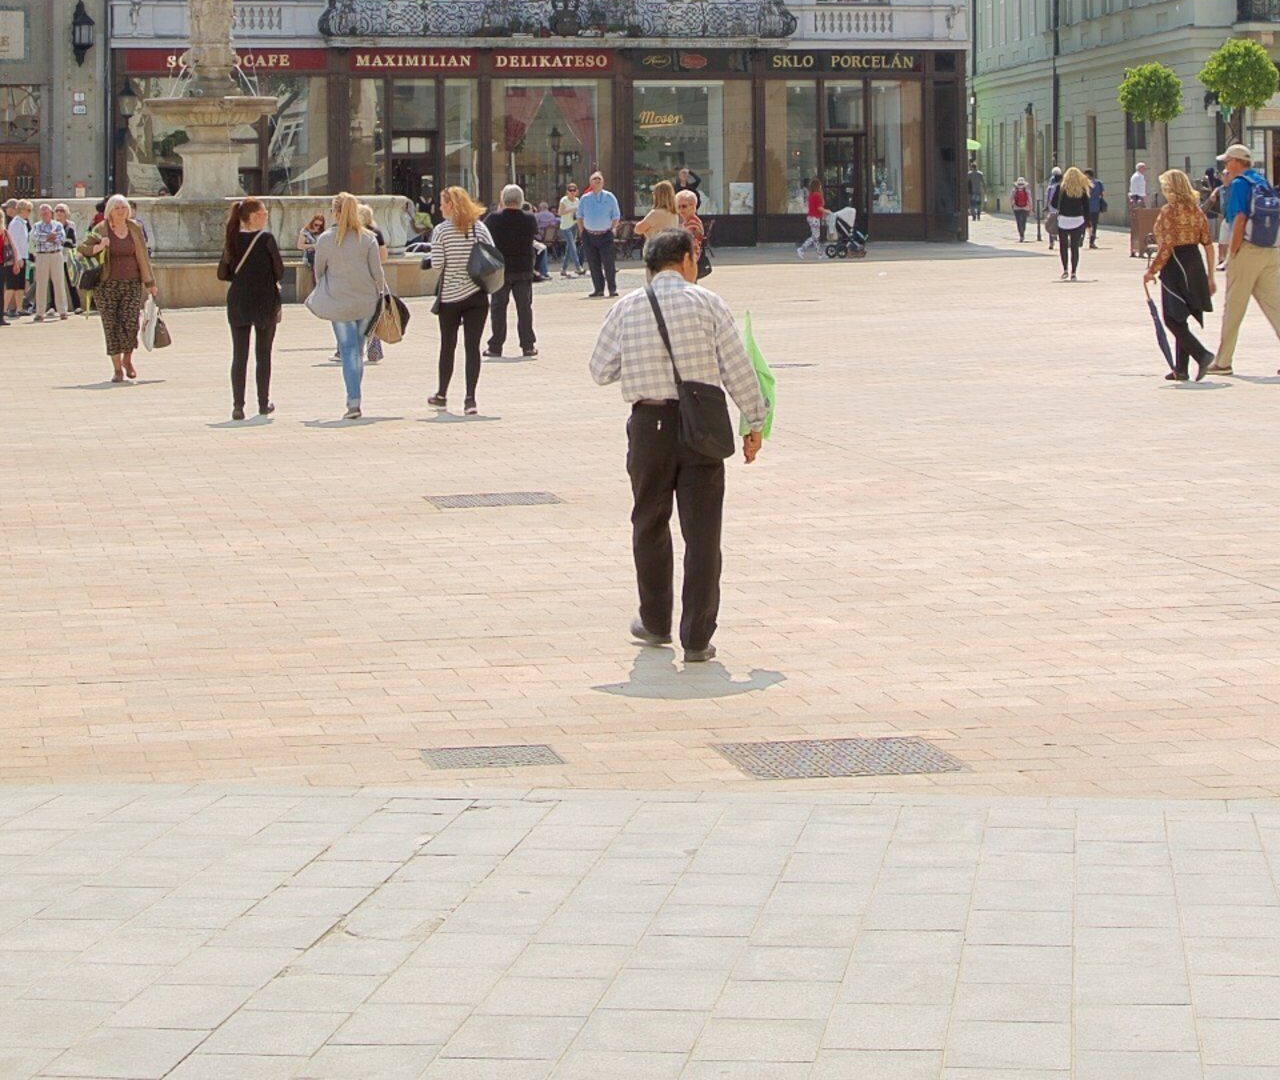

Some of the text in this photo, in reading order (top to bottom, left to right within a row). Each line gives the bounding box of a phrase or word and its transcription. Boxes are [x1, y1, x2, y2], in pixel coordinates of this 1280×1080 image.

[166, 54, 290, 68] SCOCAFE
[355, 54, 608, 68] MAXIMILIAN DELIKATESO
[772, 52, 915, 69] SKLO PORCELÁN
